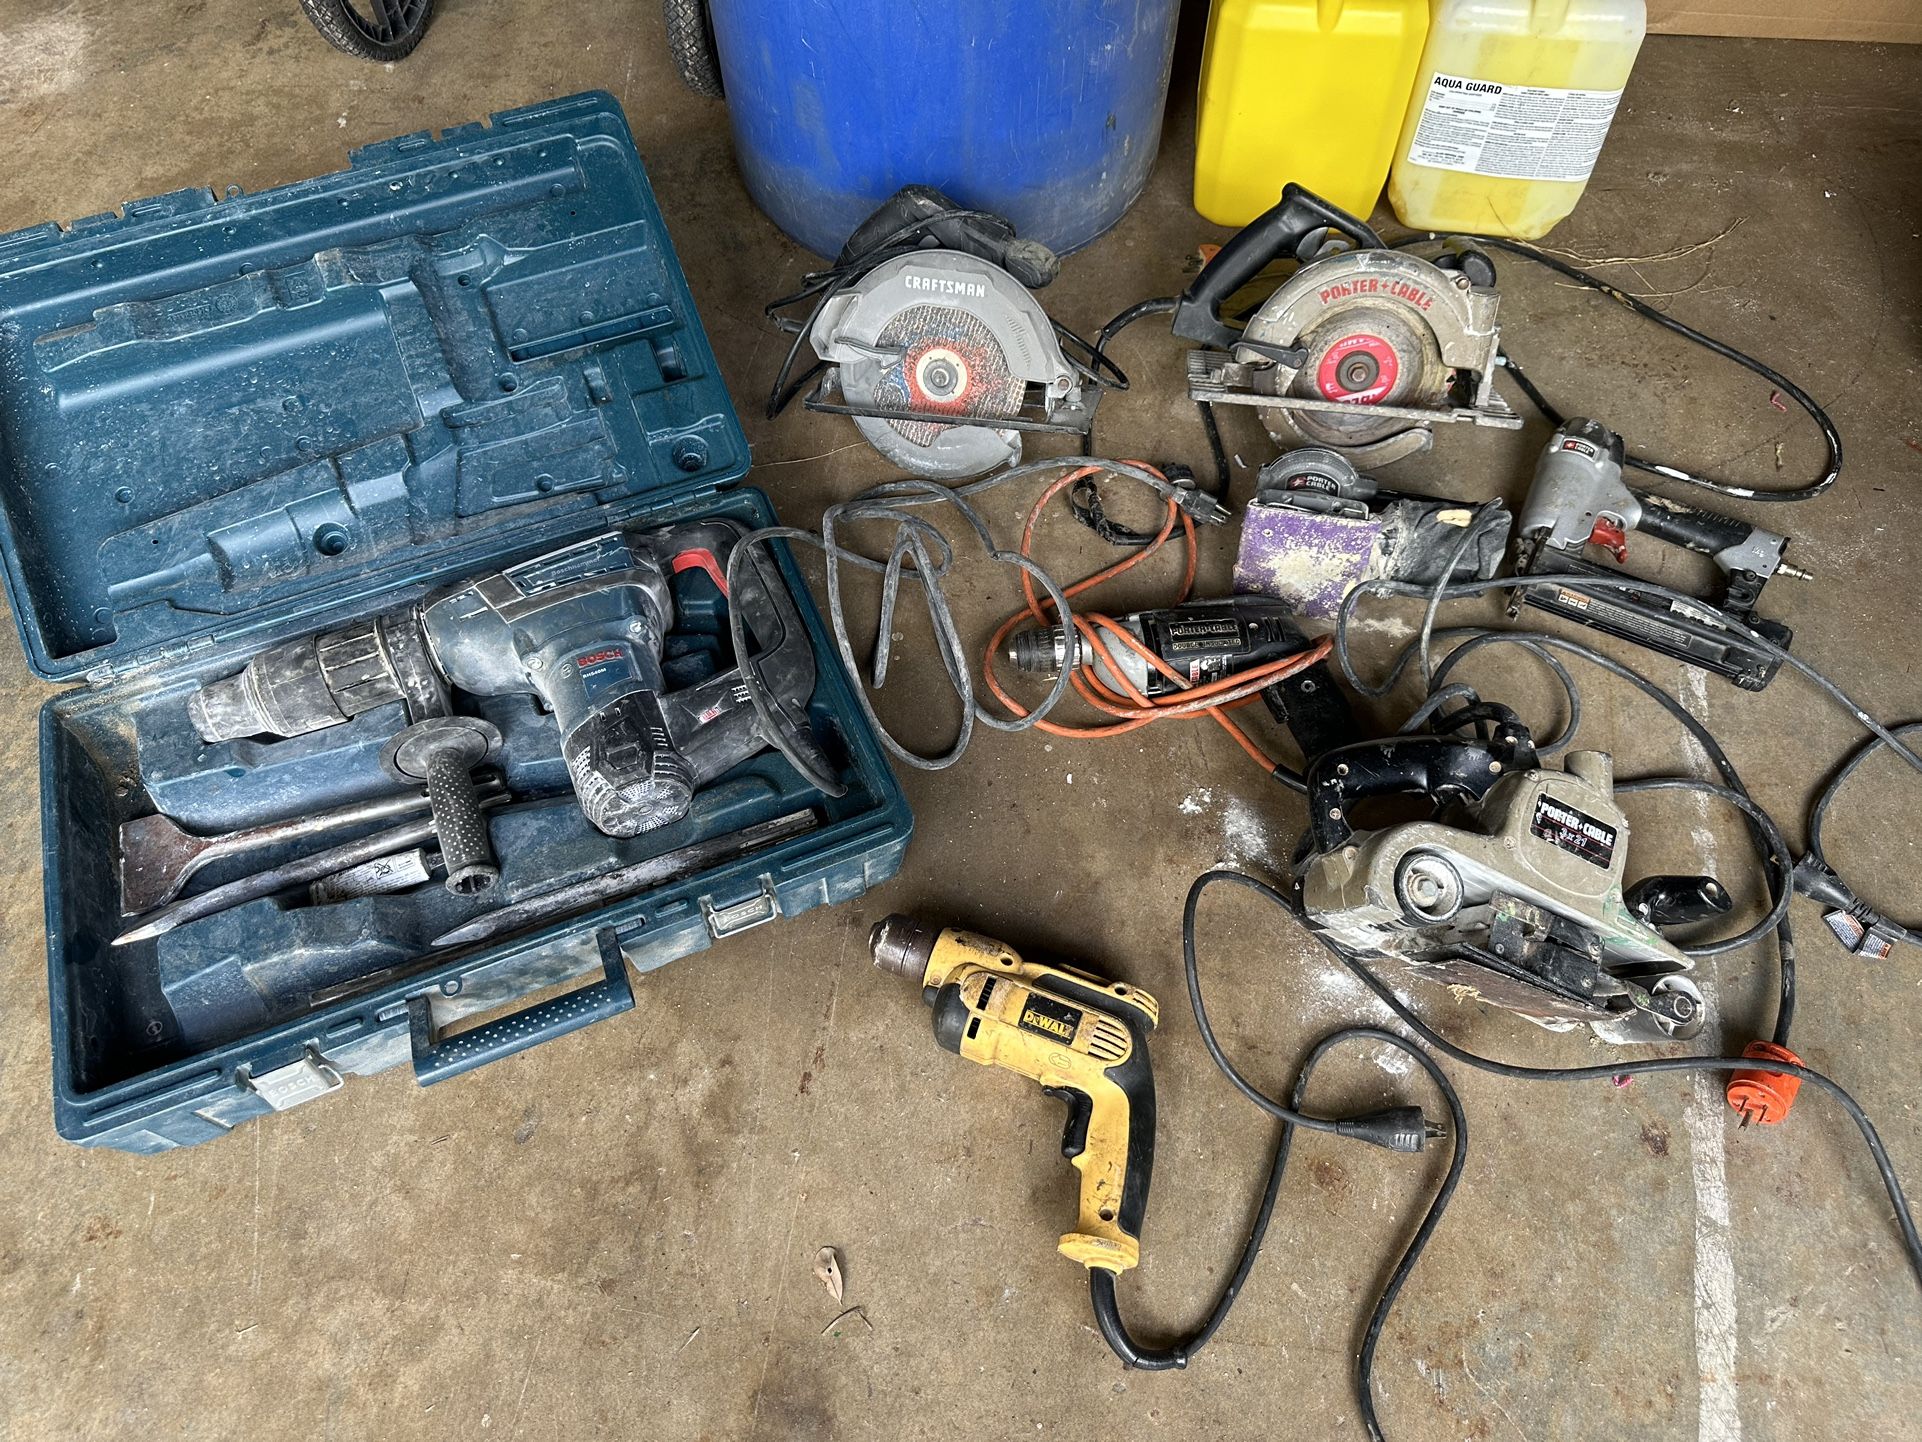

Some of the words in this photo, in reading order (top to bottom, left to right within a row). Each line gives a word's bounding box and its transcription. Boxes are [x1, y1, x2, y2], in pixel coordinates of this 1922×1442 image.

[1434, 76, 1462, 89] AQUA
[1465, 82, 1502, 95] GUARD
[905, 275, 985, 298] CRAFTSMAN
[1319, 278, 1379, 305] PORTER
[1390, 279, 1433, 311] CABLE
[1305, 480, 1331, 492] CABLE
[1306, 475, 1336, 490] PORTER
[577, 648, 623, 668] BOSCH
[1540, 802, 1580, 830] PORTER
[1582, 822, 1614, 847] CABLE
